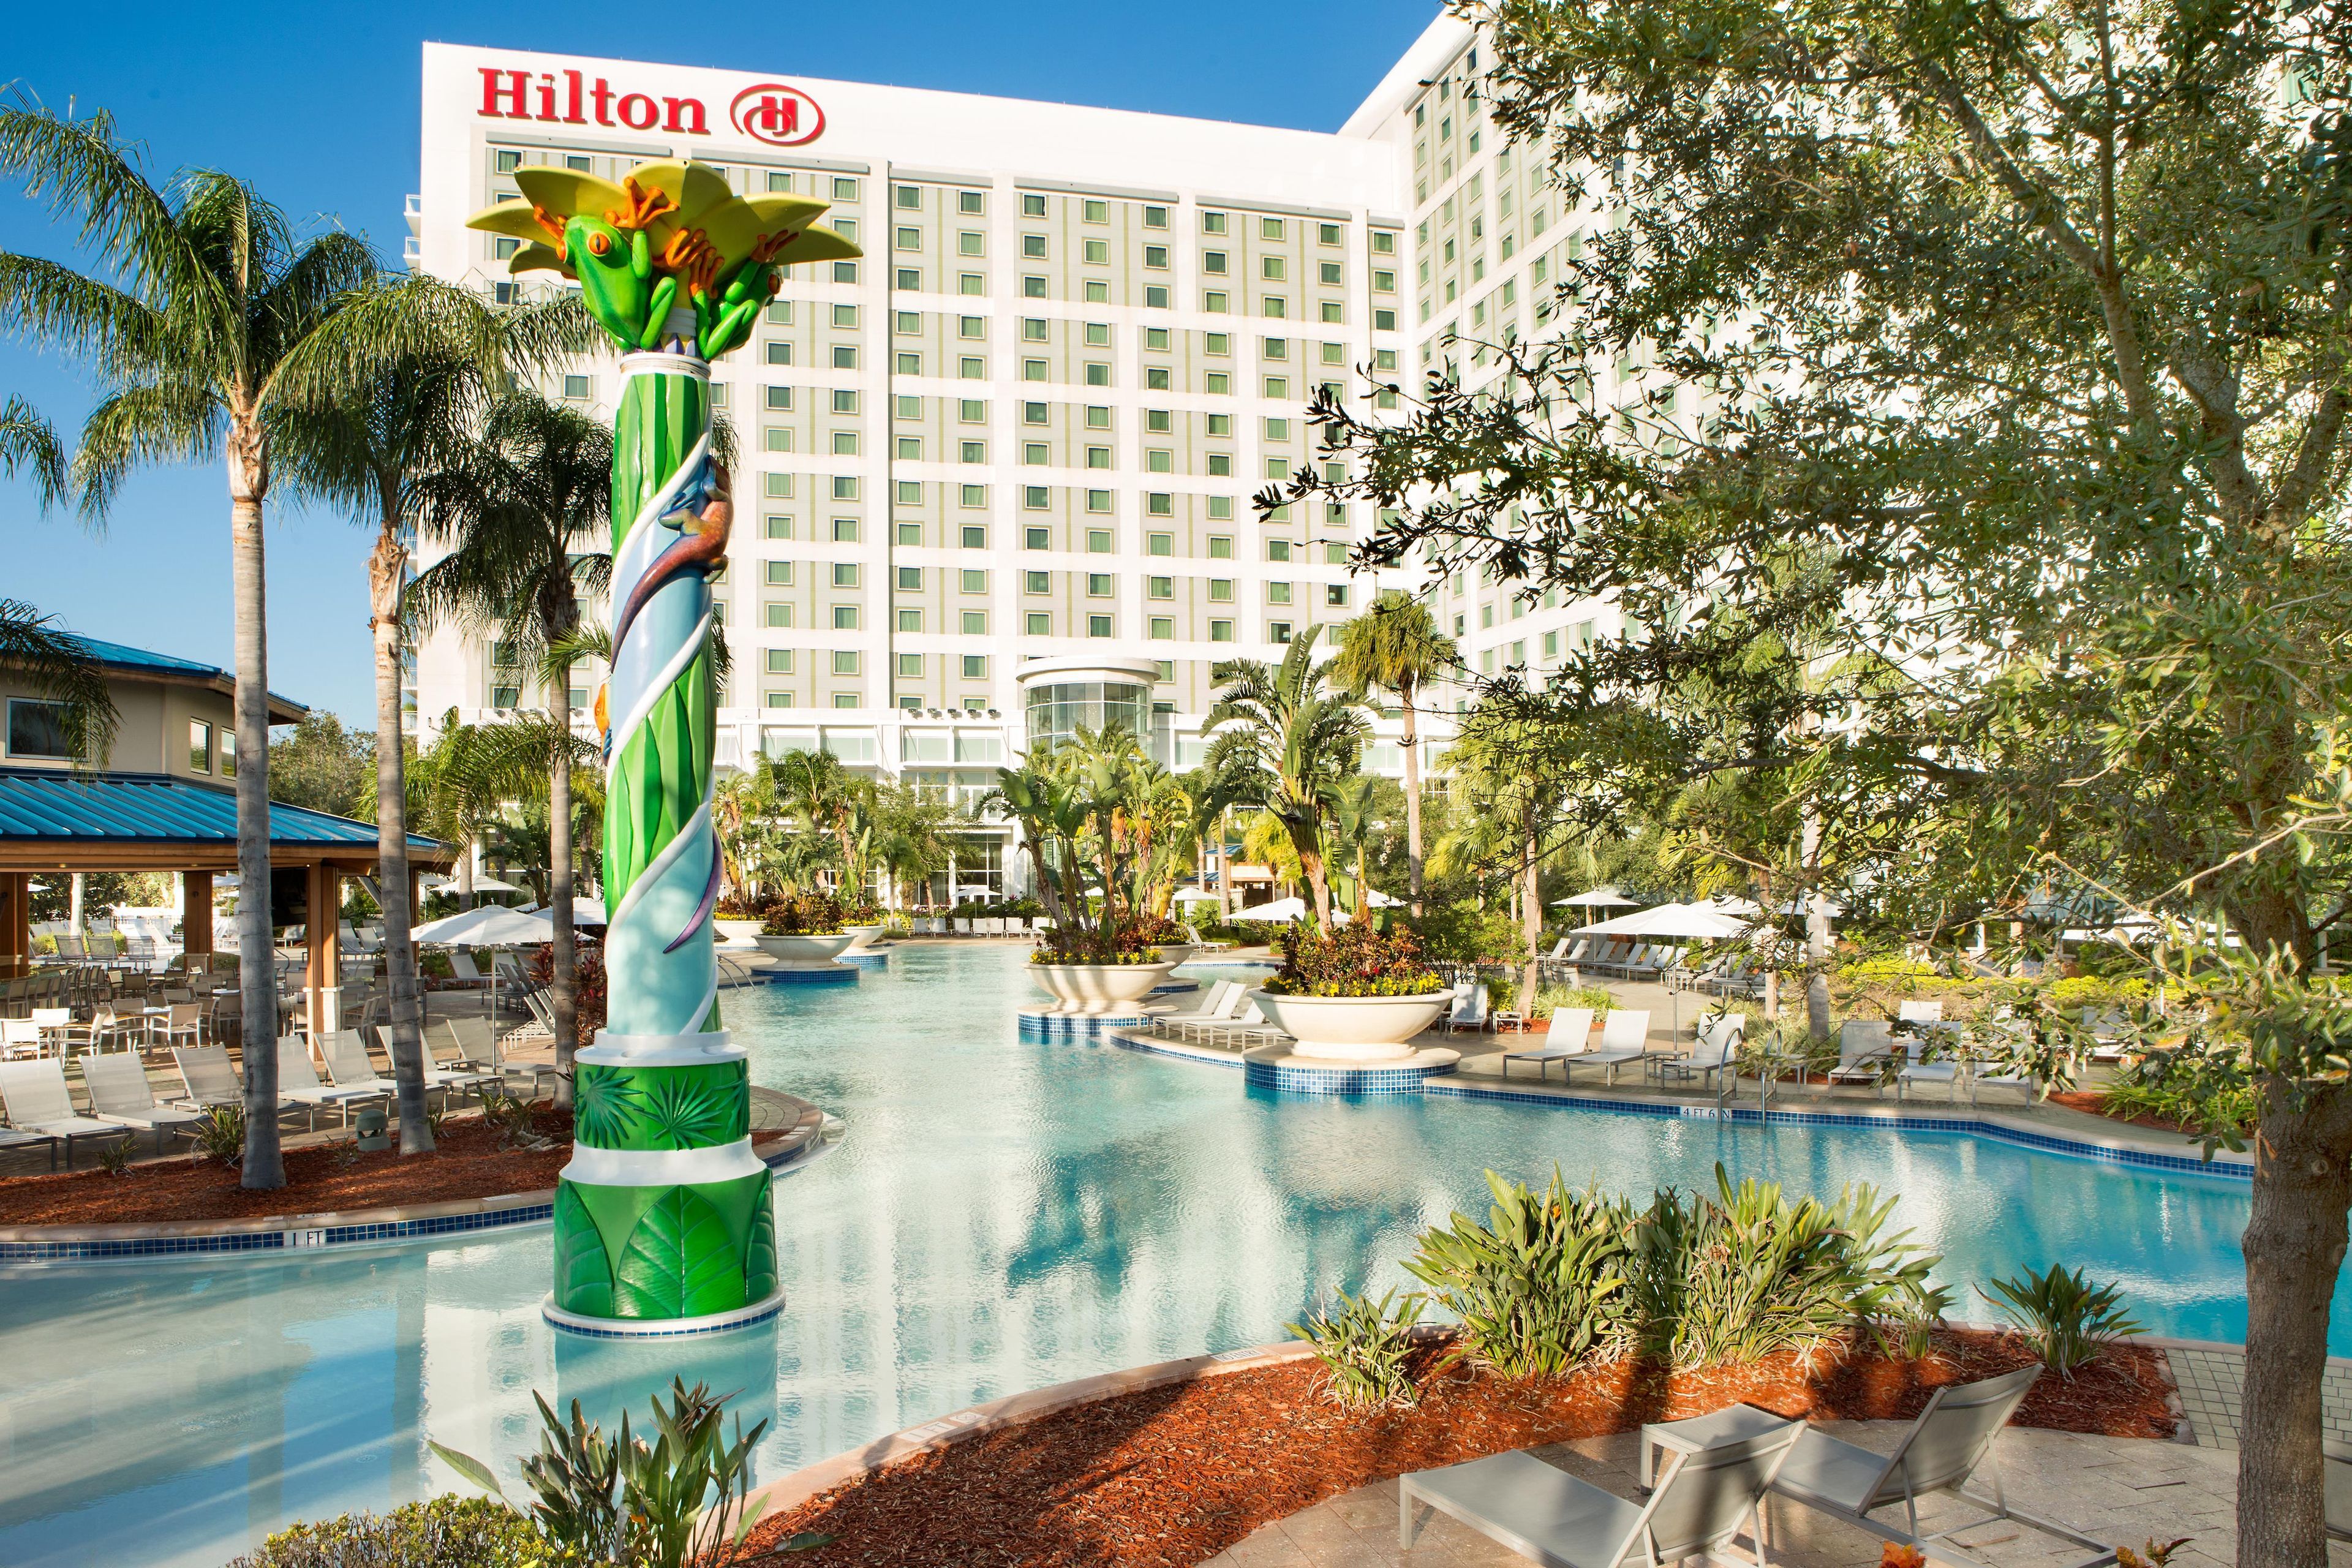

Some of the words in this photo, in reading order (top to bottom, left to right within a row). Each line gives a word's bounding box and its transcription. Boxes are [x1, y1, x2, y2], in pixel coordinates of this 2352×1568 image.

[477, 67, 710, 135] Hilton
[1683, 1107, 1689, 1117] 4
[1694, 1108, 1703, 1117] FT
[1708, 1109, 1714, 1117] 6
[307, 1231, 323, 1245] FT
[924, 1422, 949, 1433] FT
